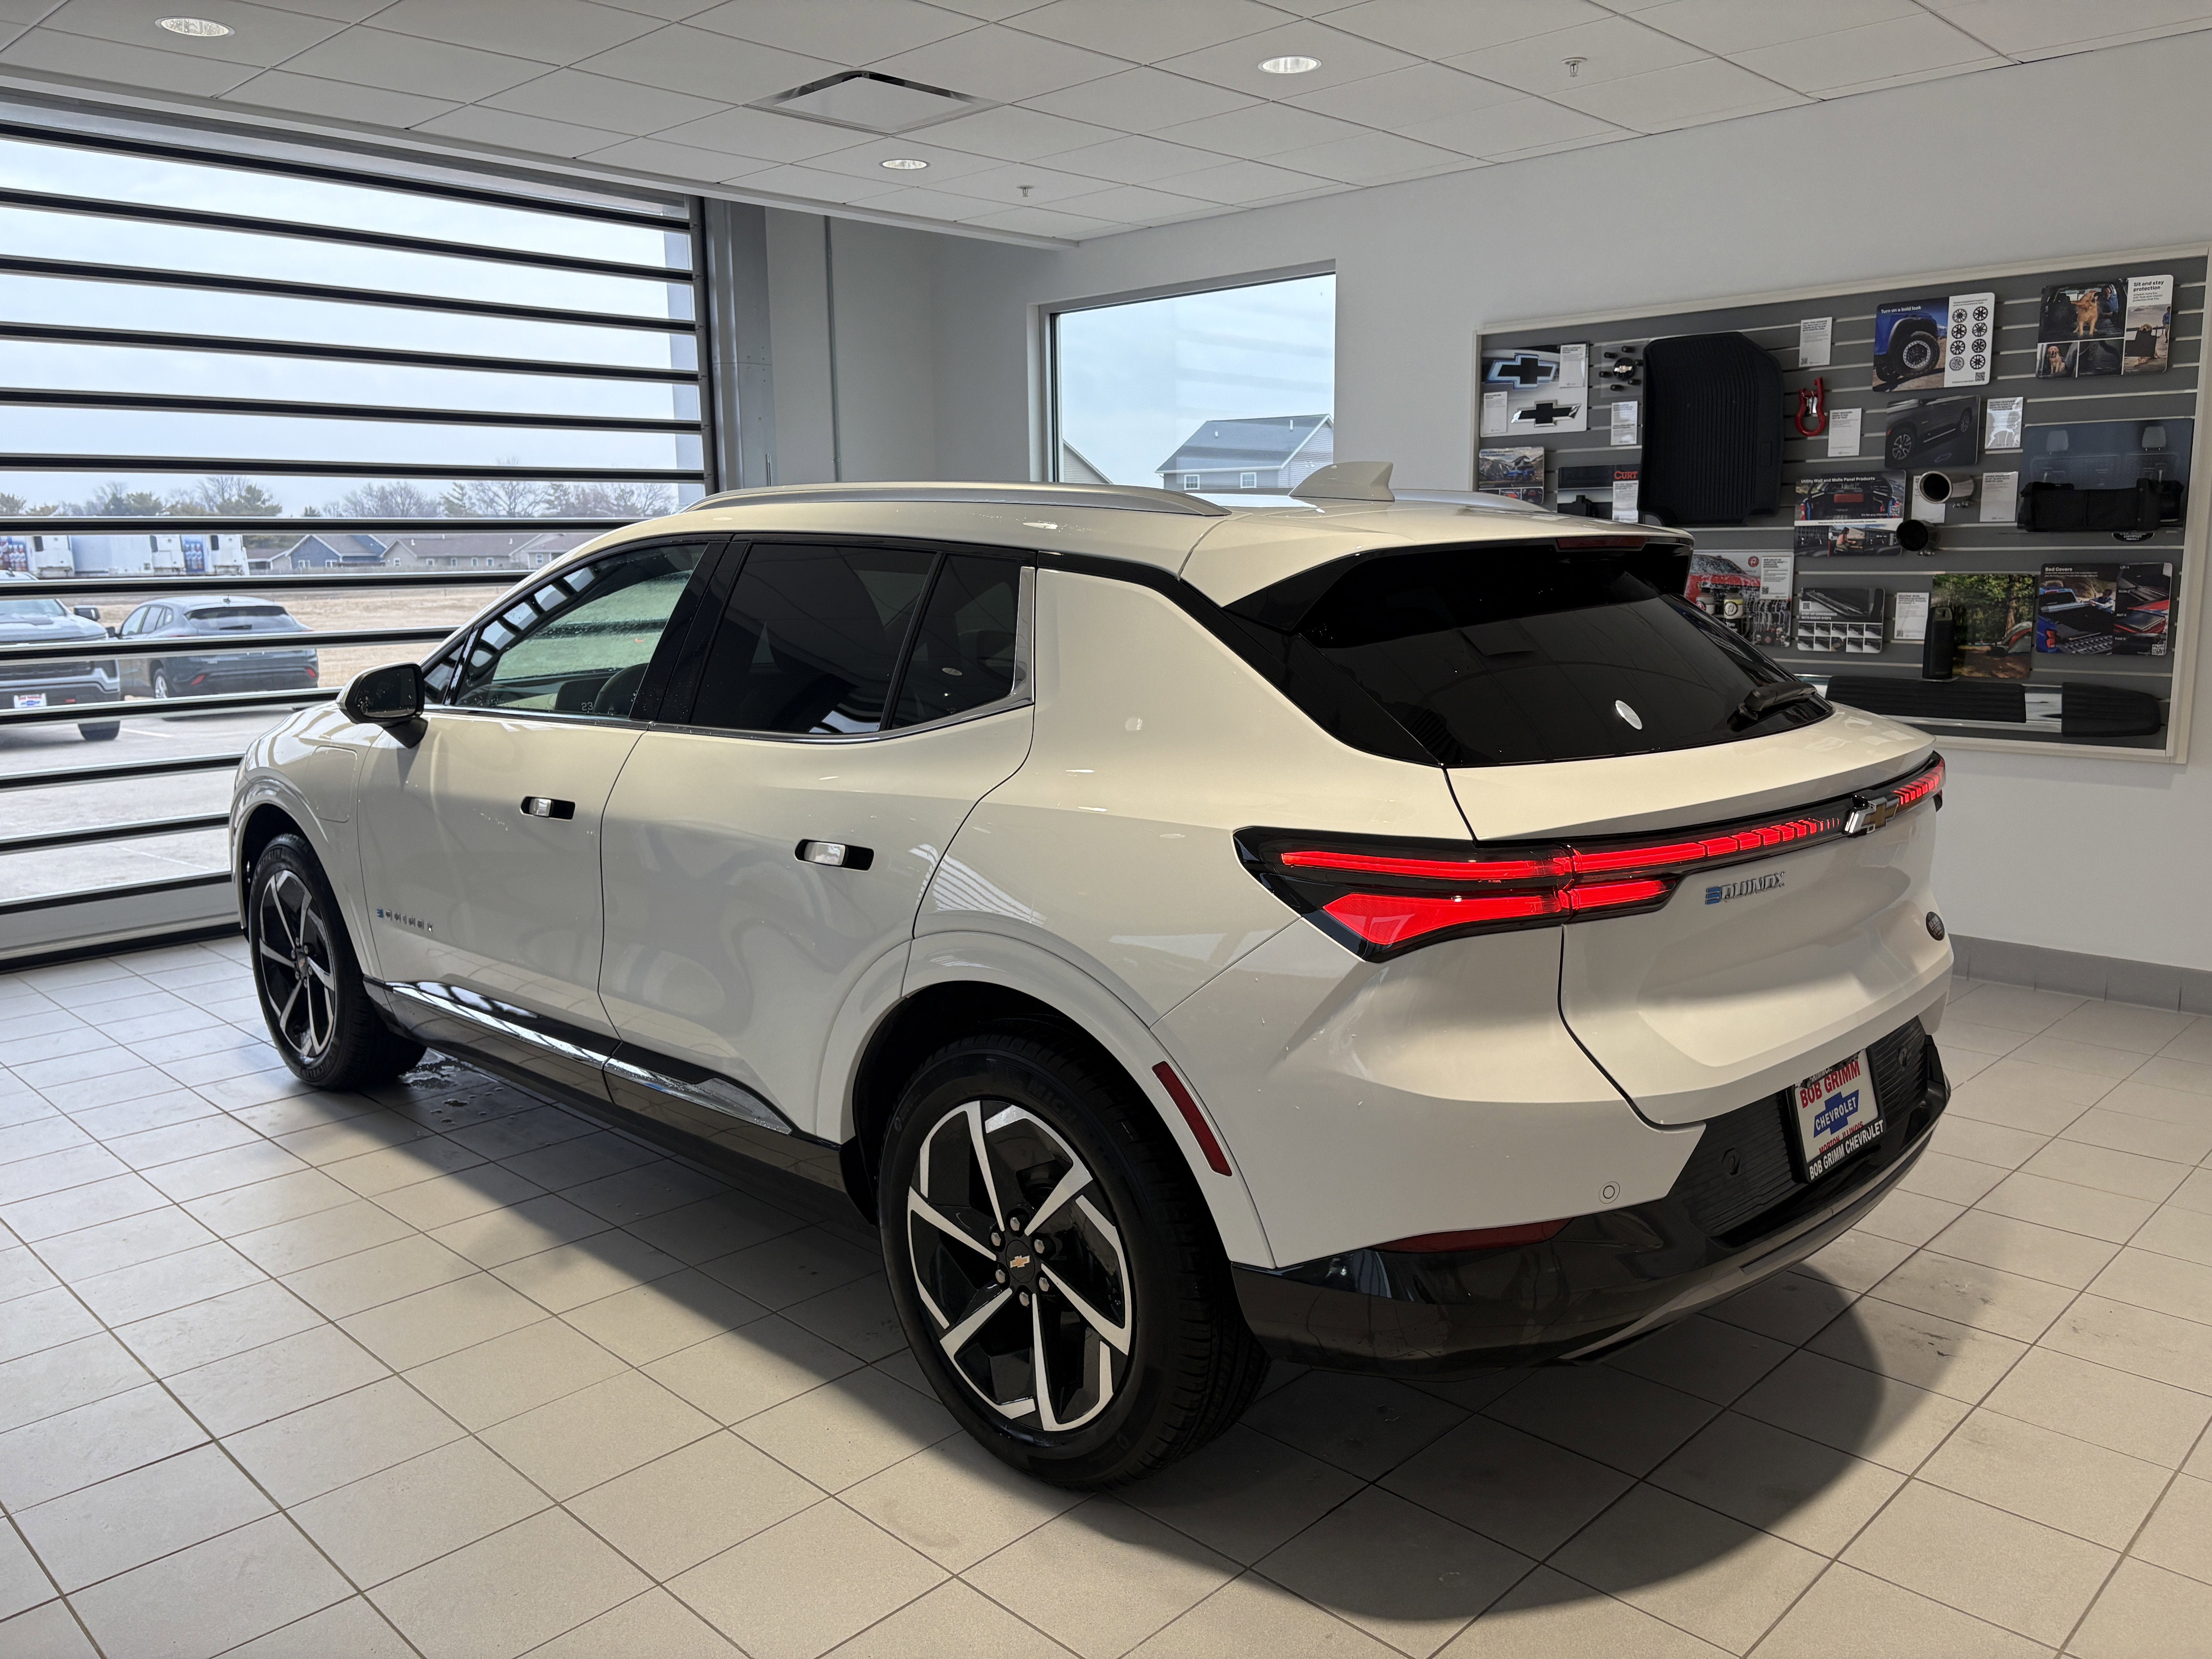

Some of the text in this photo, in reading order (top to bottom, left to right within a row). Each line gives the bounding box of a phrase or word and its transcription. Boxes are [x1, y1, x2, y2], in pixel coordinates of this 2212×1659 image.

[581, 702, 593, 711] 23
[1705, 871, 1785, 905] EQUINOX
[1800, 1080, 1822, 1109] BOB
[1824, 1061, 1861, 1094] GRIMM
[1815, 1096, 1856, 1131] CHEVROLET
[1809, 1120, 1884, 1180] BOB GRIMM CHEVROLET
